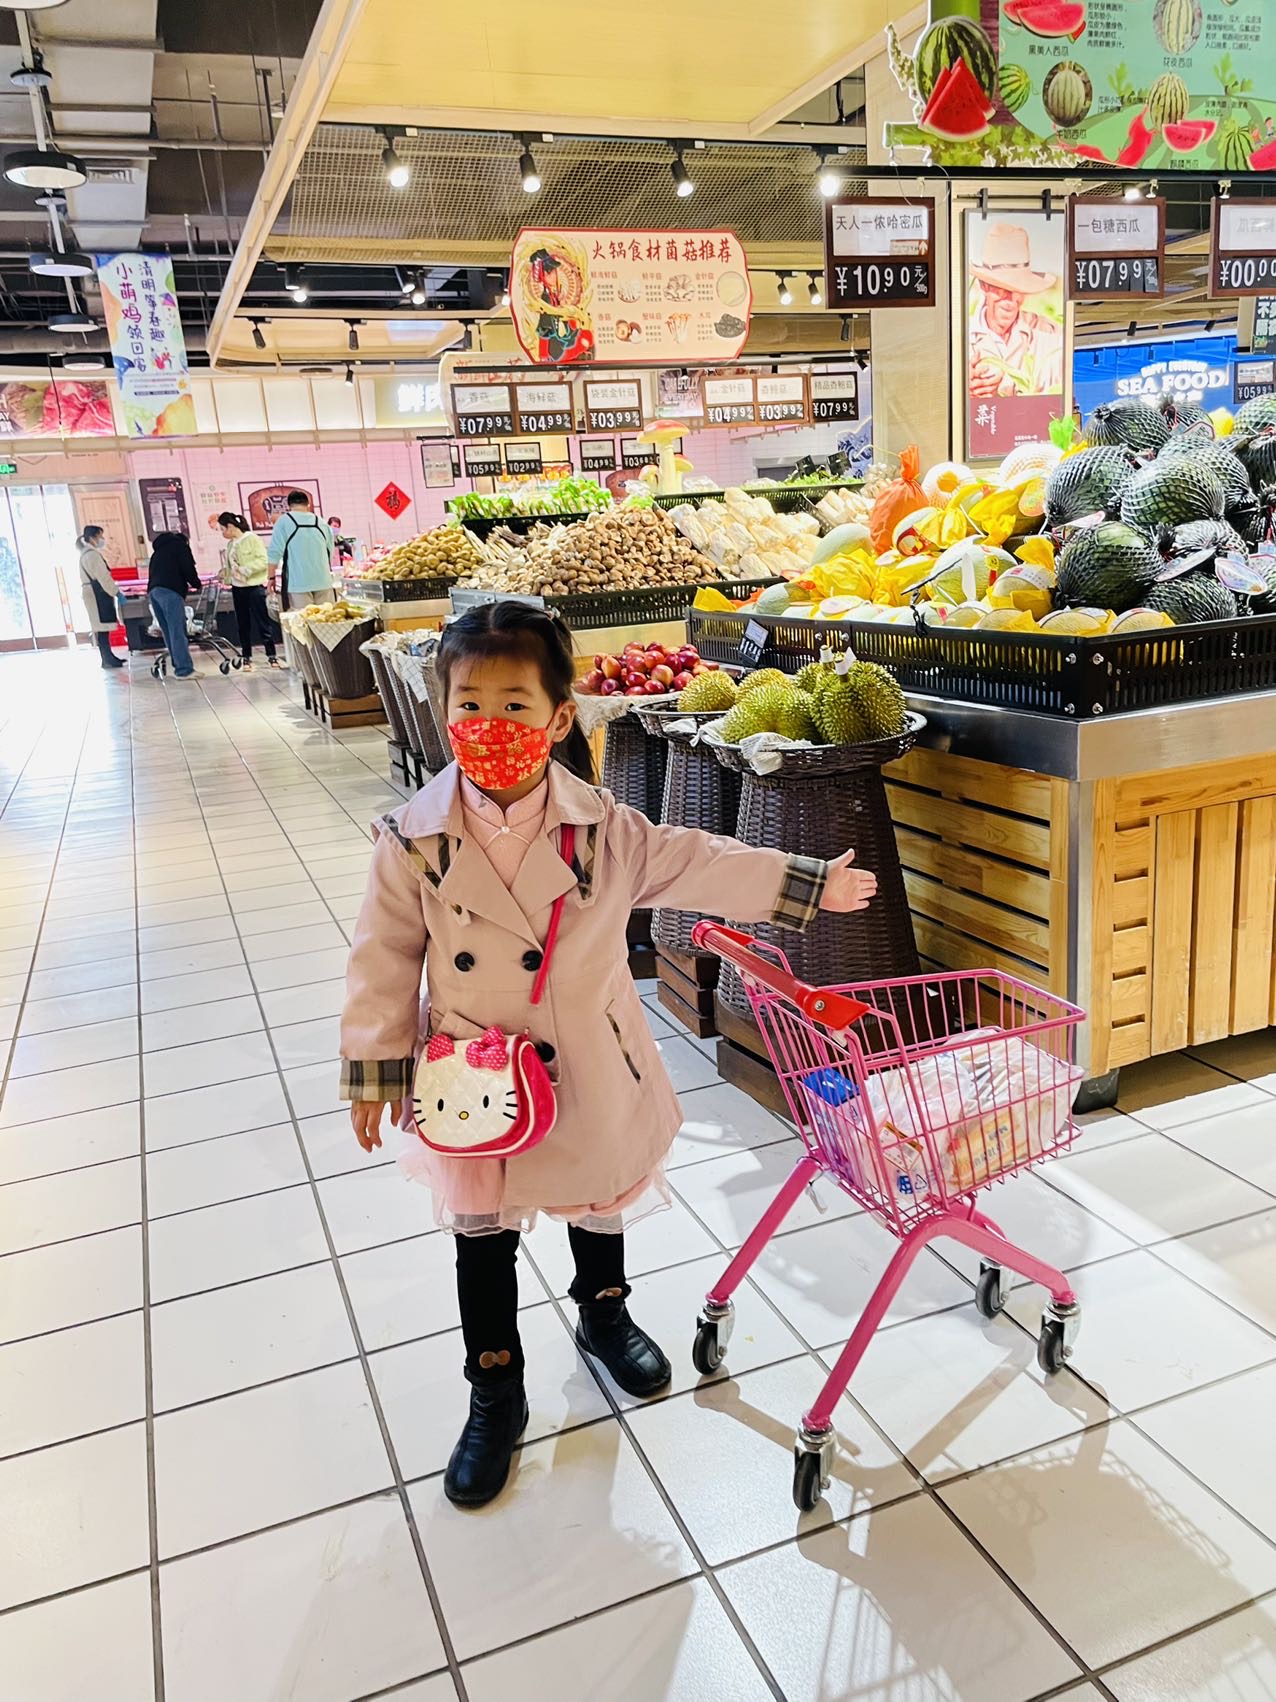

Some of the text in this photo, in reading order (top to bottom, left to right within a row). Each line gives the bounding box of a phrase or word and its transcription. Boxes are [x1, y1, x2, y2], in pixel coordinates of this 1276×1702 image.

[1028, 45, 1069, 56] 黑美人西瓜
[835, 214, 923, 231] 天人一侬哈密瓜
[1077, 218, 1141, 234] 一包糖西瓜
[592, 238, 732, 263] 火锅食材菌菇推荐
[834, 265, 911, 297] ¥10.90
[1075, 260, 1143, 289] ¥07.99
[1116, 377, 1157, 396] SEA
[1162, 369, 1226, 391] FOOD
